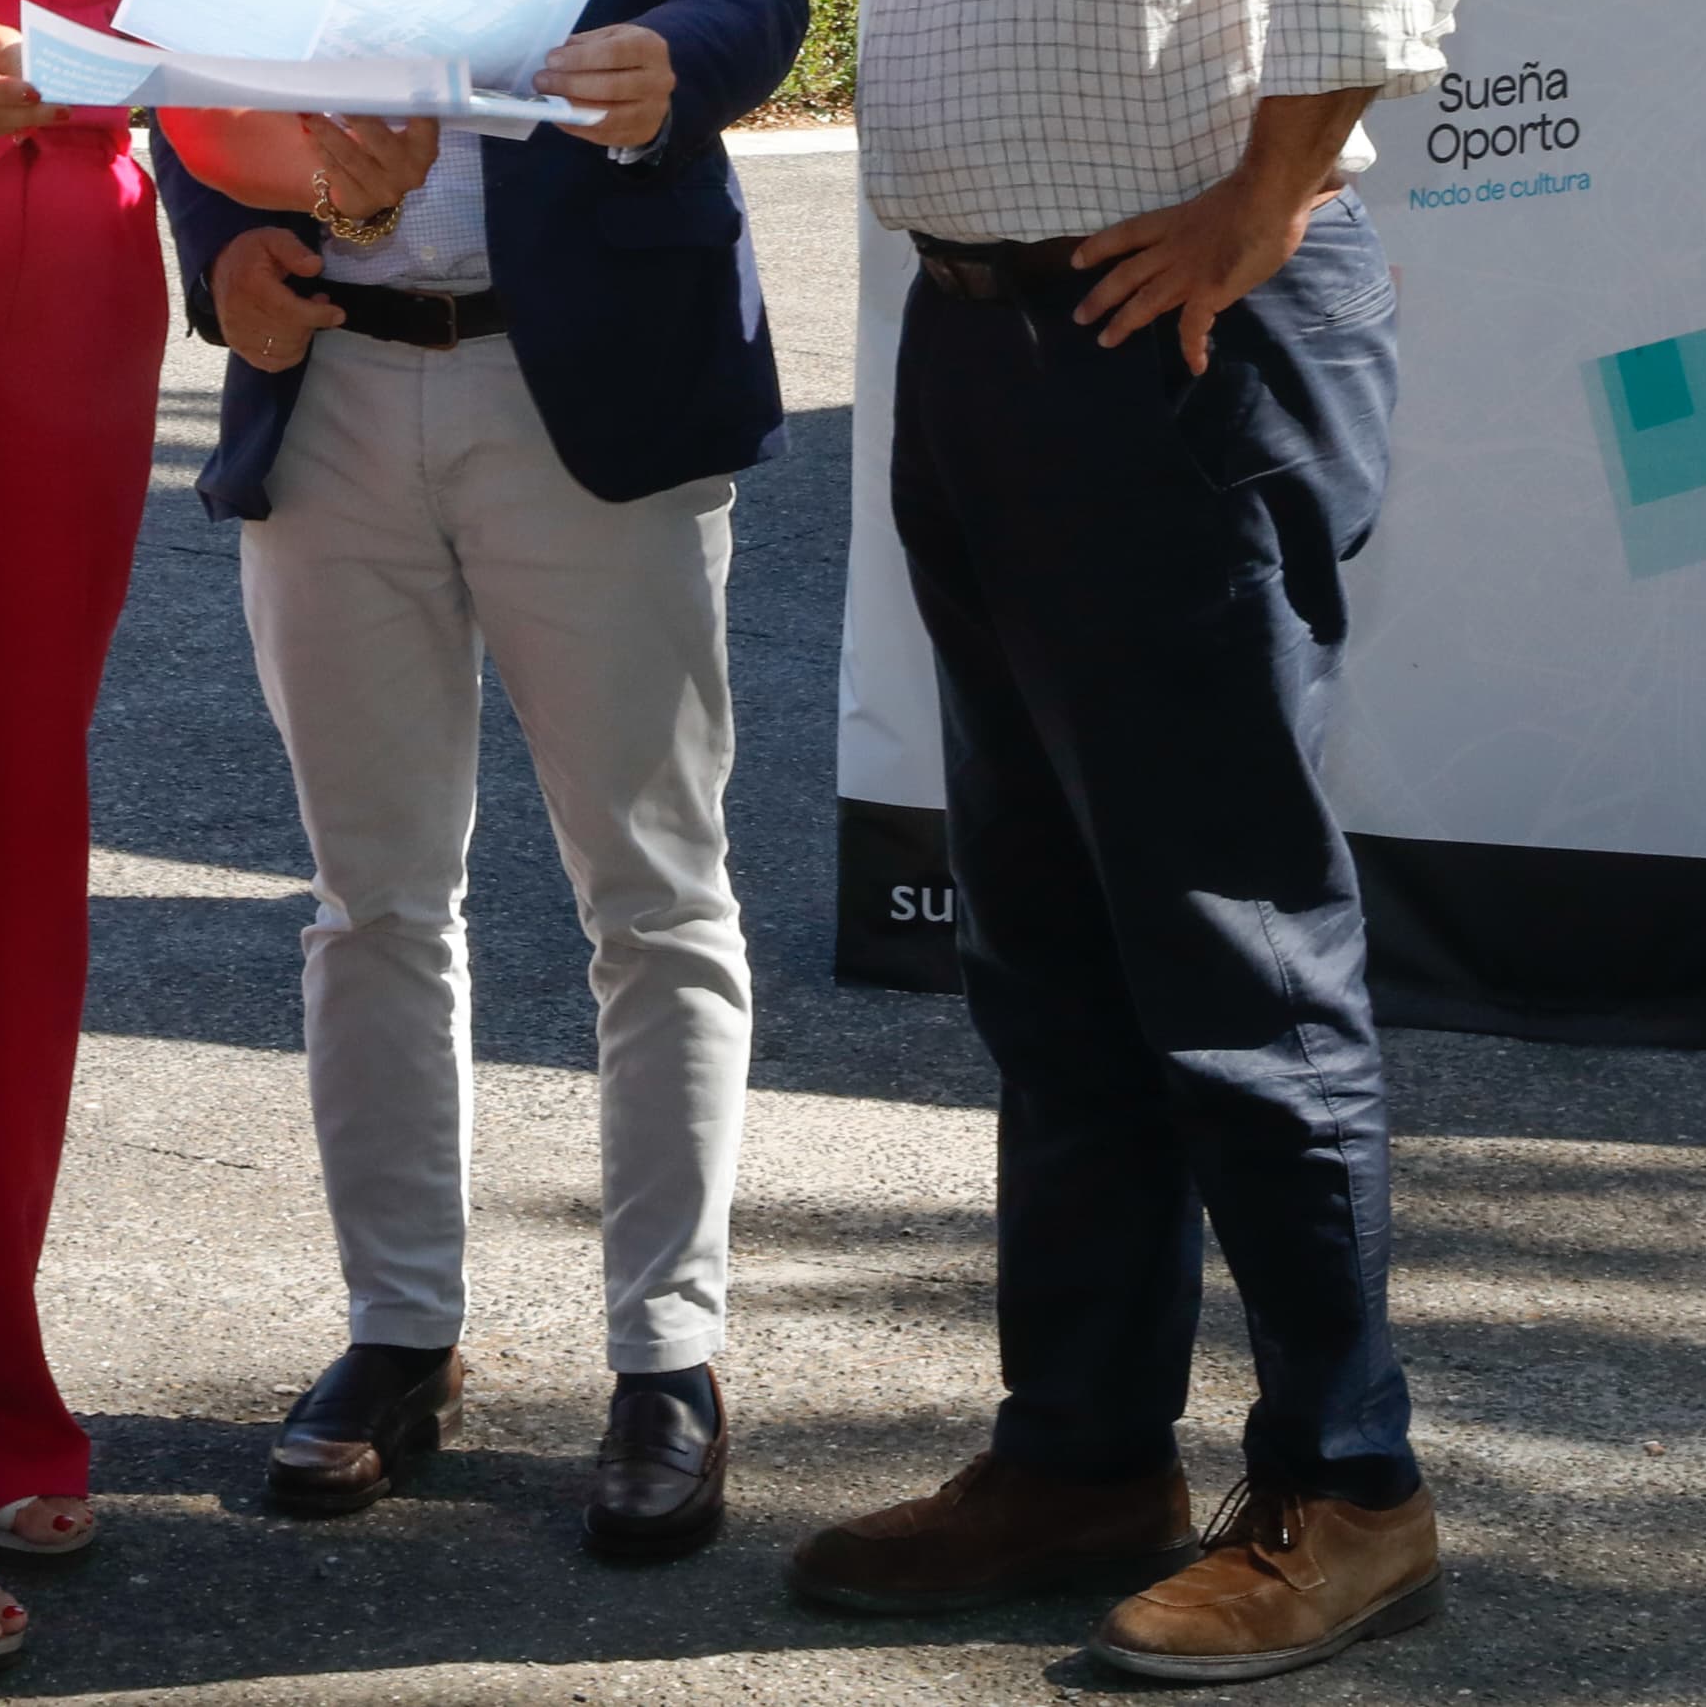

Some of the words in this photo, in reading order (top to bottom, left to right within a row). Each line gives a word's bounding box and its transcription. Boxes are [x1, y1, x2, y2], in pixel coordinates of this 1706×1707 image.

[1438, 61, 1568, 113] Sueña
[1427, 113, 1580, 169] Oporto
[1410, 183, 1471, 209] Nodo
[1475, 178, 1504, 203] de
[1509, 172, 1591, 198] cultura
